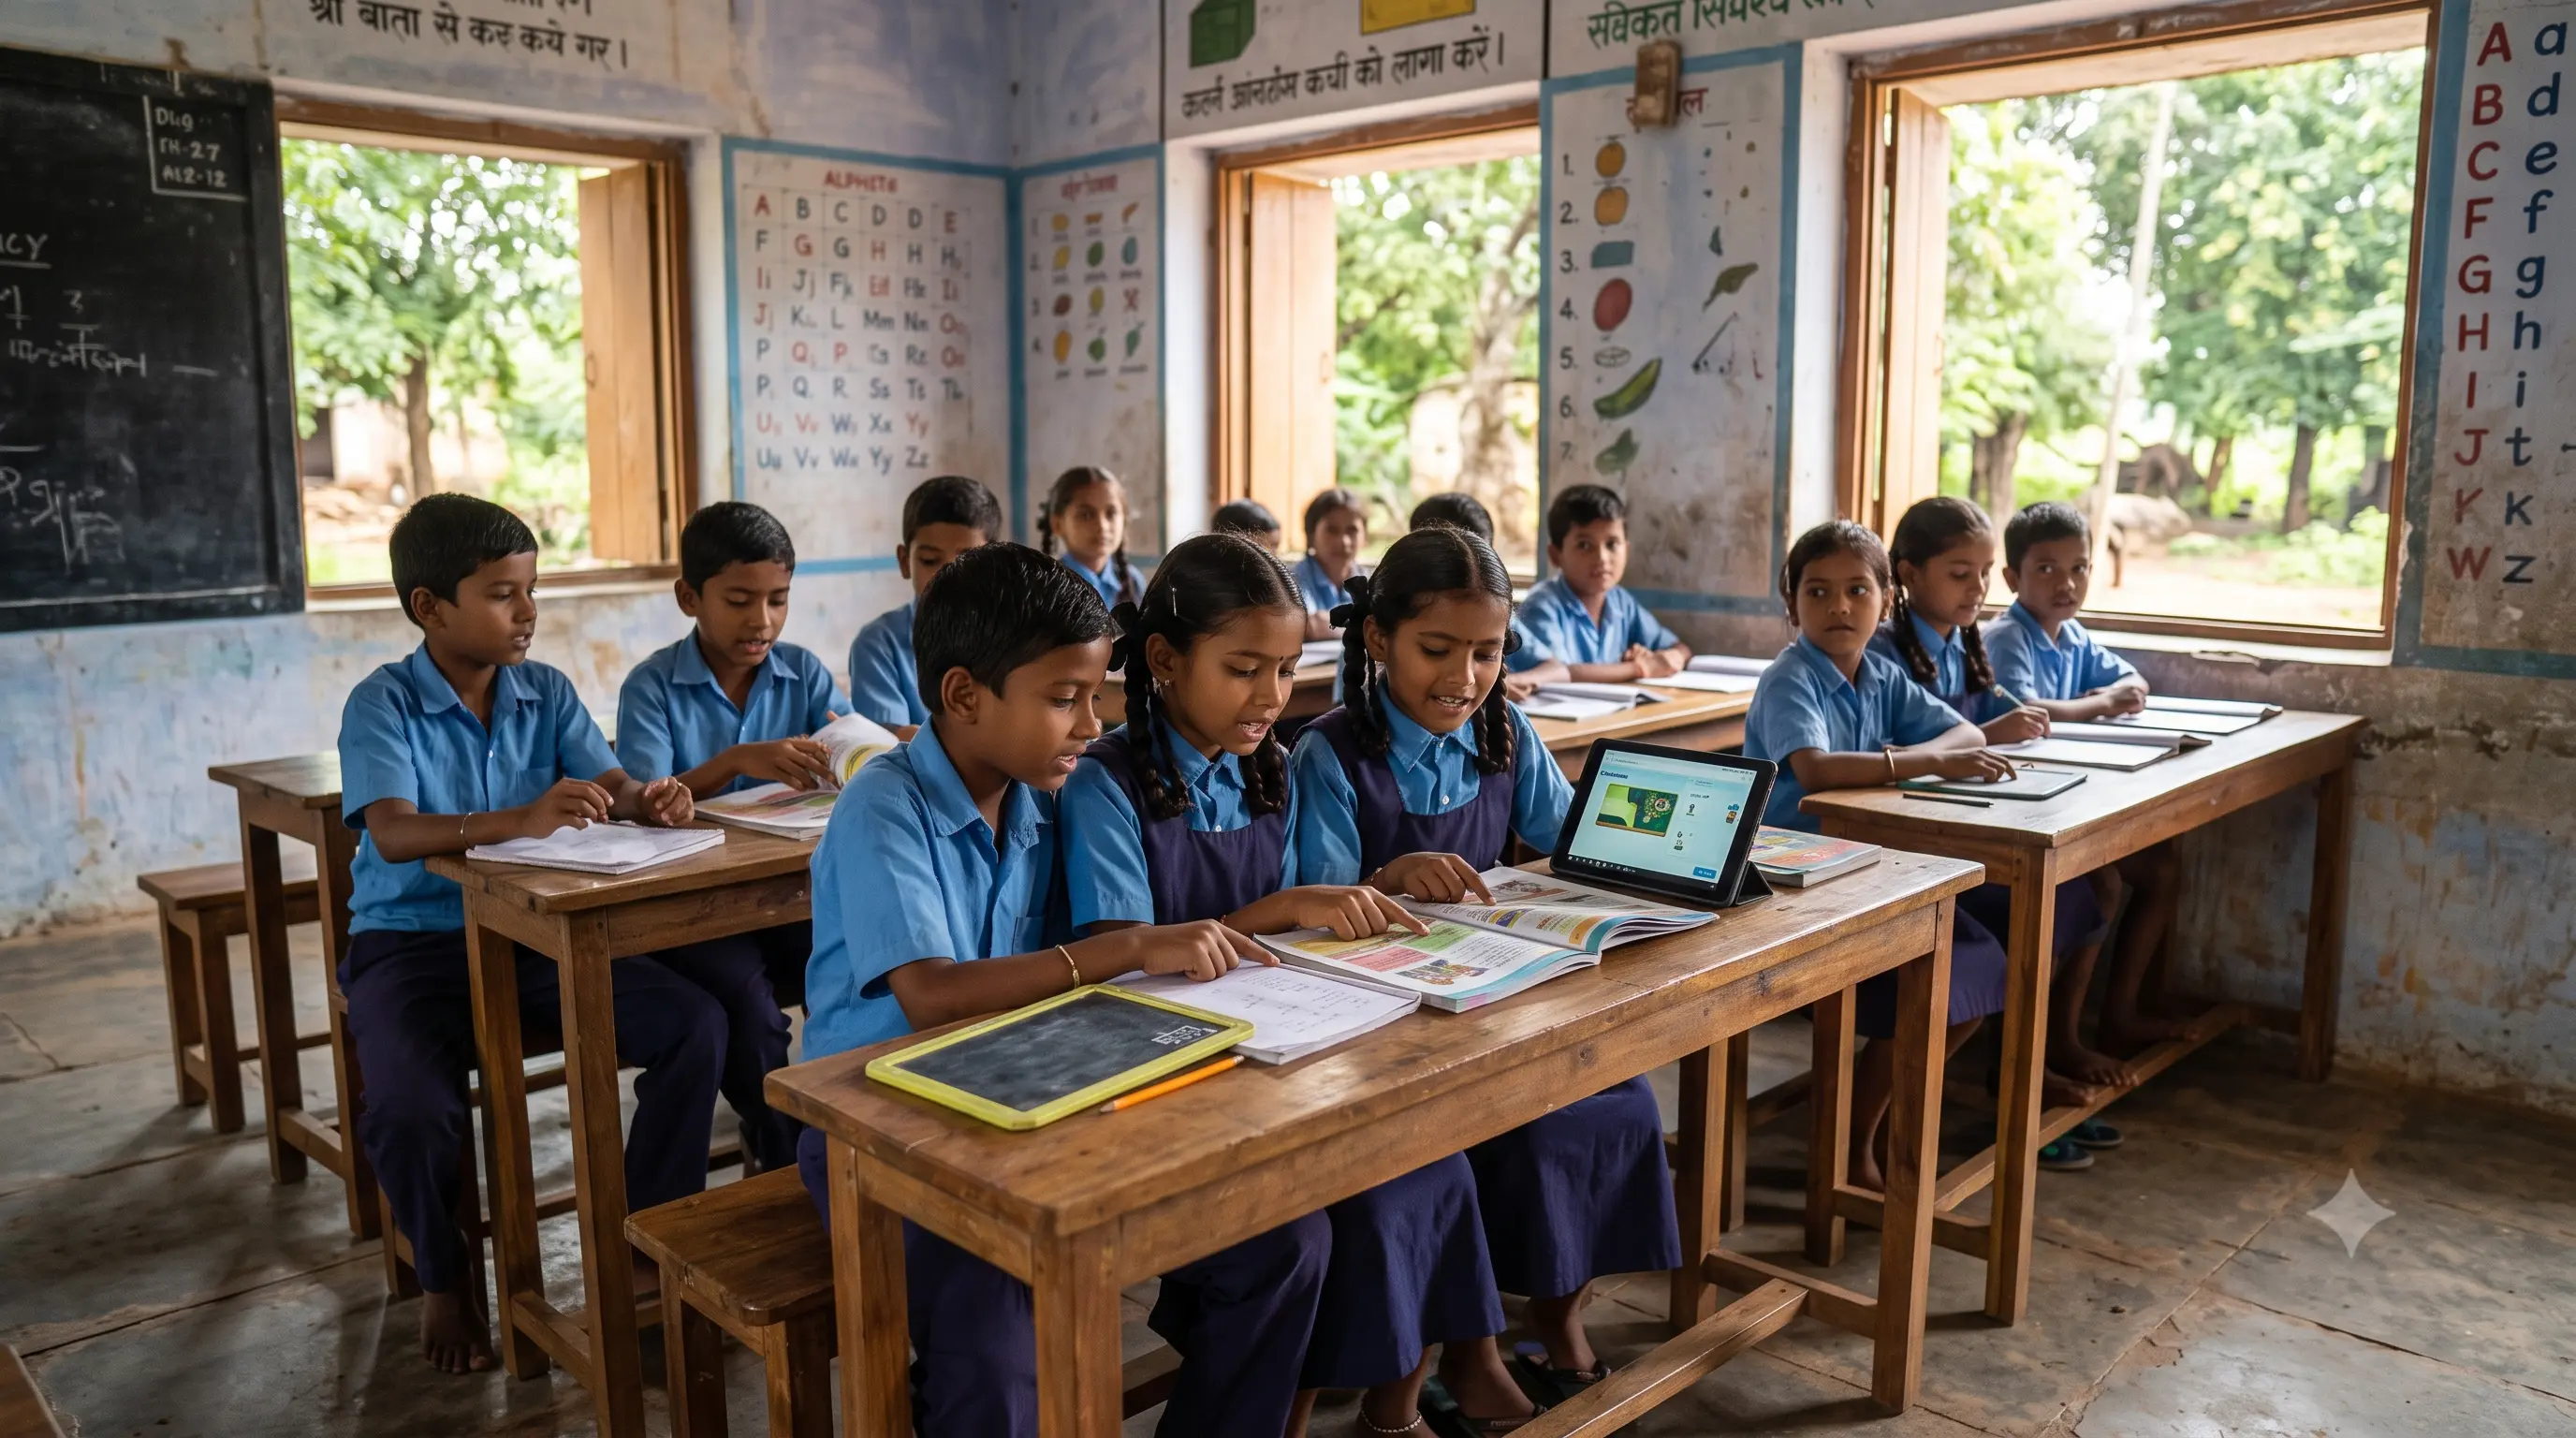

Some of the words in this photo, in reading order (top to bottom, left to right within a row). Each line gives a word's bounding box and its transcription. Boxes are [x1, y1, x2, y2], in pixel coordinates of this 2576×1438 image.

[433, 1, 460, 45] से
[2477, 22, 2512, 66] A
[2534, 22, 2568, 56] a
[1355, 45, 1383, 85] को
[2472, 83, 2504, 125] B
[2526, 71, 2561, 117] d
[1561, 153, 1575, 177] 1.
[2466, 140, 2500, 181] C
[2525, 141, 2558, 176] e
[754, 193, 771, 218] A
[796, 196, 812, 221] B
[833, 200, 849, 224] C
[871, 202, 887, 227] D
[907, 206, 924, 230] D
[944, 210, 959, 234] E
[1559, 201, 1580, 225] 2.
[2464, 197, 2495, 239] F
[2523, 189, 2554, 234] f
[755, 228, 768, 253] F
[794, 233, 813, 257] G
[833, 236, 850, 259] G
[871, 239, 886, 262] H
[907, 242, 923, 264] H
[1559, 250, 1579, 273] 3.
[2457, 255, 2493, 294] G
[2516, 255, 2546, 299] g
[2457, 313, 2490, 352] H
[2513, 311, 2541, 351] h
[2515, 372, 2527, 408] i
[2453, 428, 2490, 467] J
[2505, 426, 2532, 466] t
[2446, 546, 2492, 582] W
